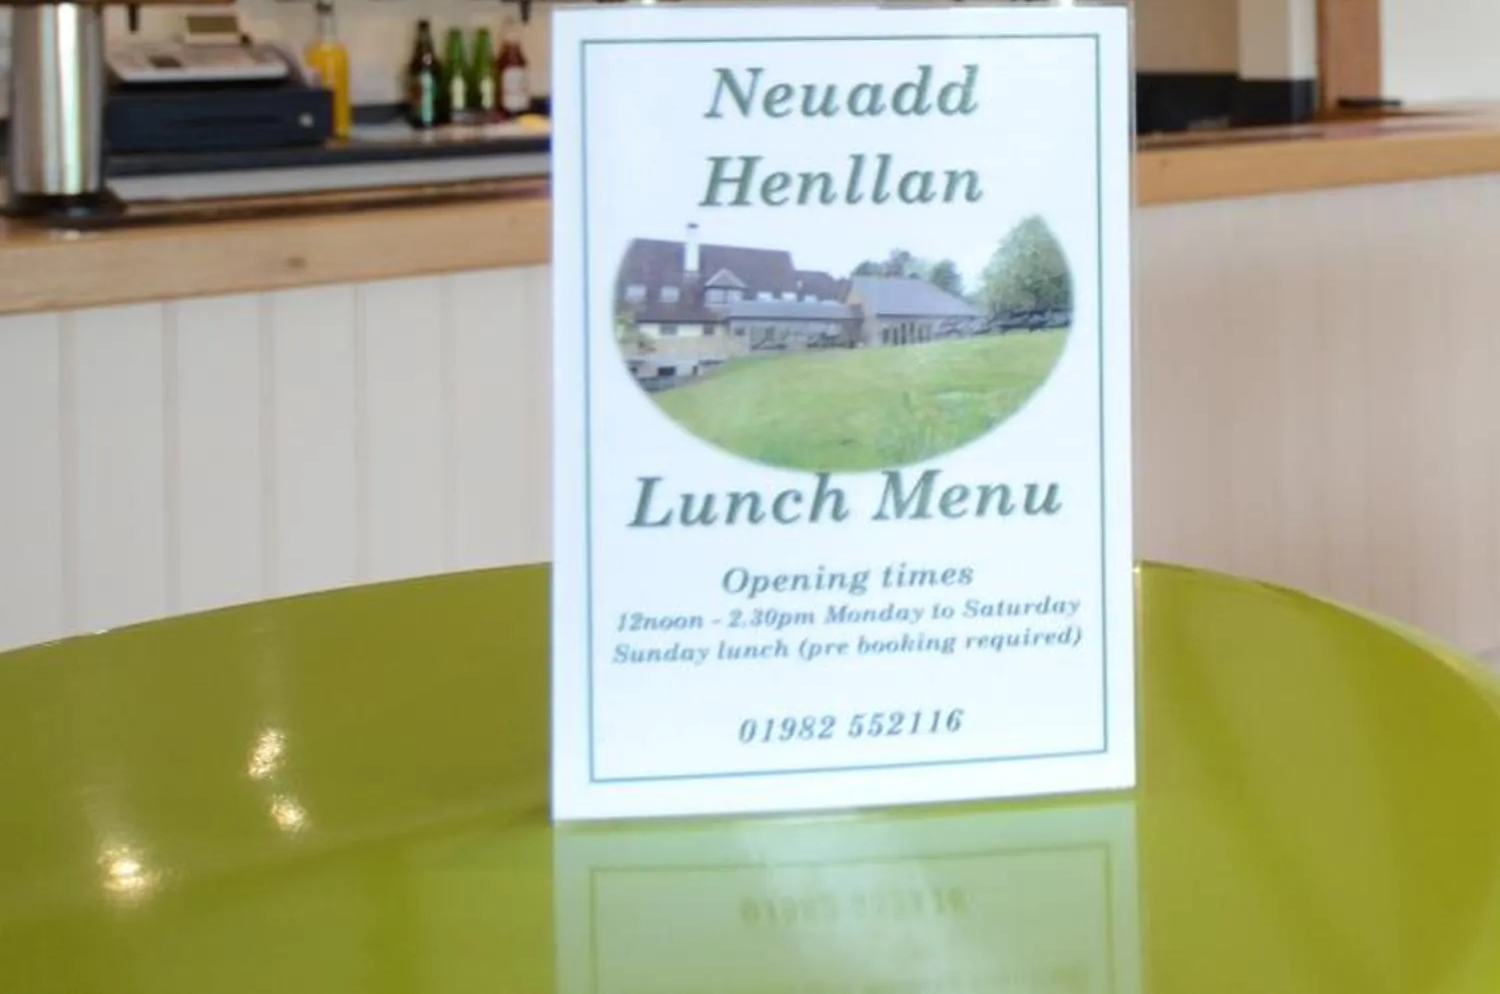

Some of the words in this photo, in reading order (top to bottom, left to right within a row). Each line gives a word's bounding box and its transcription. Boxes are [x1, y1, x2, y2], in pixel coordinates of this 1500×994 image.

[703, 64, 979, 120] Neuadd
[697, 153, 983, 208] Henllan
[627, 473, 849, 528] Lunch
[871, 469, 1063, 520] Menu
[721, 565, 870, 600] Opening
[882, 562, 974, 589] times
[617, 611, 704, 633] 12noon
[727, 608, 815, 631] 2.30pm
[823, 602, 925, 625] Monday
[931, 603, 956, 620] to
[962, 595, 1081, 618] Saturday
[612, 642, 710, 665] Sunday
[716, 638, 790, 661] lunch
[797, 637, 850, 662] (pre
[856, 633, 957, 655] booking
[965, 625, 1082, 653] required)
[738, 714, 837, 744] 01982
[847, 707, 965, 739] 552116
